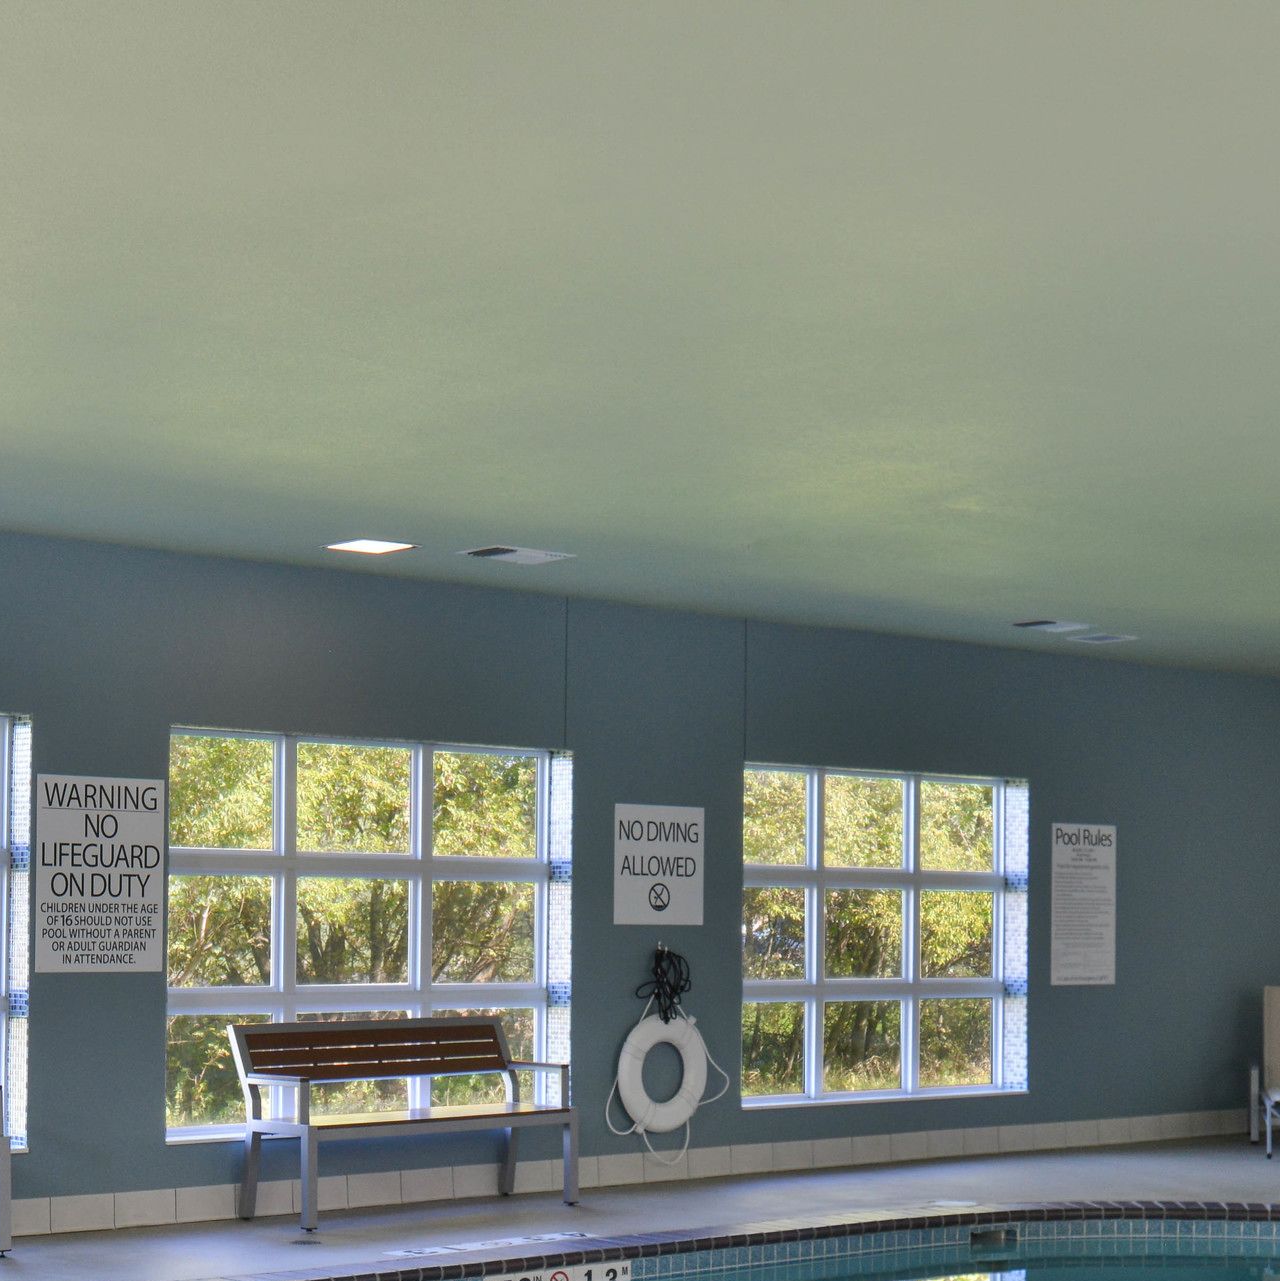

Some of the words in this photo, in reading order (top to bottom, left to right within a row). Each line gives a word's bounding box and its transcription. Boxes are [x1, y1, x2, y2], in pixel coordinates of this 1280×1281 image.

[44, 782, 158, 811] WARNING
[84, 814, 118, 839] NO
[619, 820, 644, 841] NO
[647, 821, 699, 843] DIVING
[1056, 827, 1080, 845] Pool
[1083, 829, 1112, 847] Rules
[41, 842, 160, 869] LIFEGUARD
[620, 855, 696, 877] ALLOWED
[50, 872, 84, 897] ON
[90, 873, 151, 898] DUTY
[40, 902, 86, 913] CHILDREN
[88, 903, 120, 913] UNDER
[121, 903, 138, 914] THE
[140, 903, 158, 914] AGE
[46, 915, 59, 926] OF
[60, 914, 73, 927] 16
[74, 915, 112, 926] SHOULD
[114, 915, 133, 926] NOT
[135, 916, 152, 926] USE
[42, 928, 66, 939] POOL
[68, 928, 111, 939] WITHOUT
[113, 929, 120, 939] A
[122, 928, 156, 939] PARENT
[51, 941, 65, 952] OR
[66, 941, 97, 952] ADULT
[98, 941, 146, 952] GUARDIAN
[62, 954, 71, 964] IN
[74, 954, 136, 964] ATTENDANCE.
[621, 1266, 628, 1276] M
